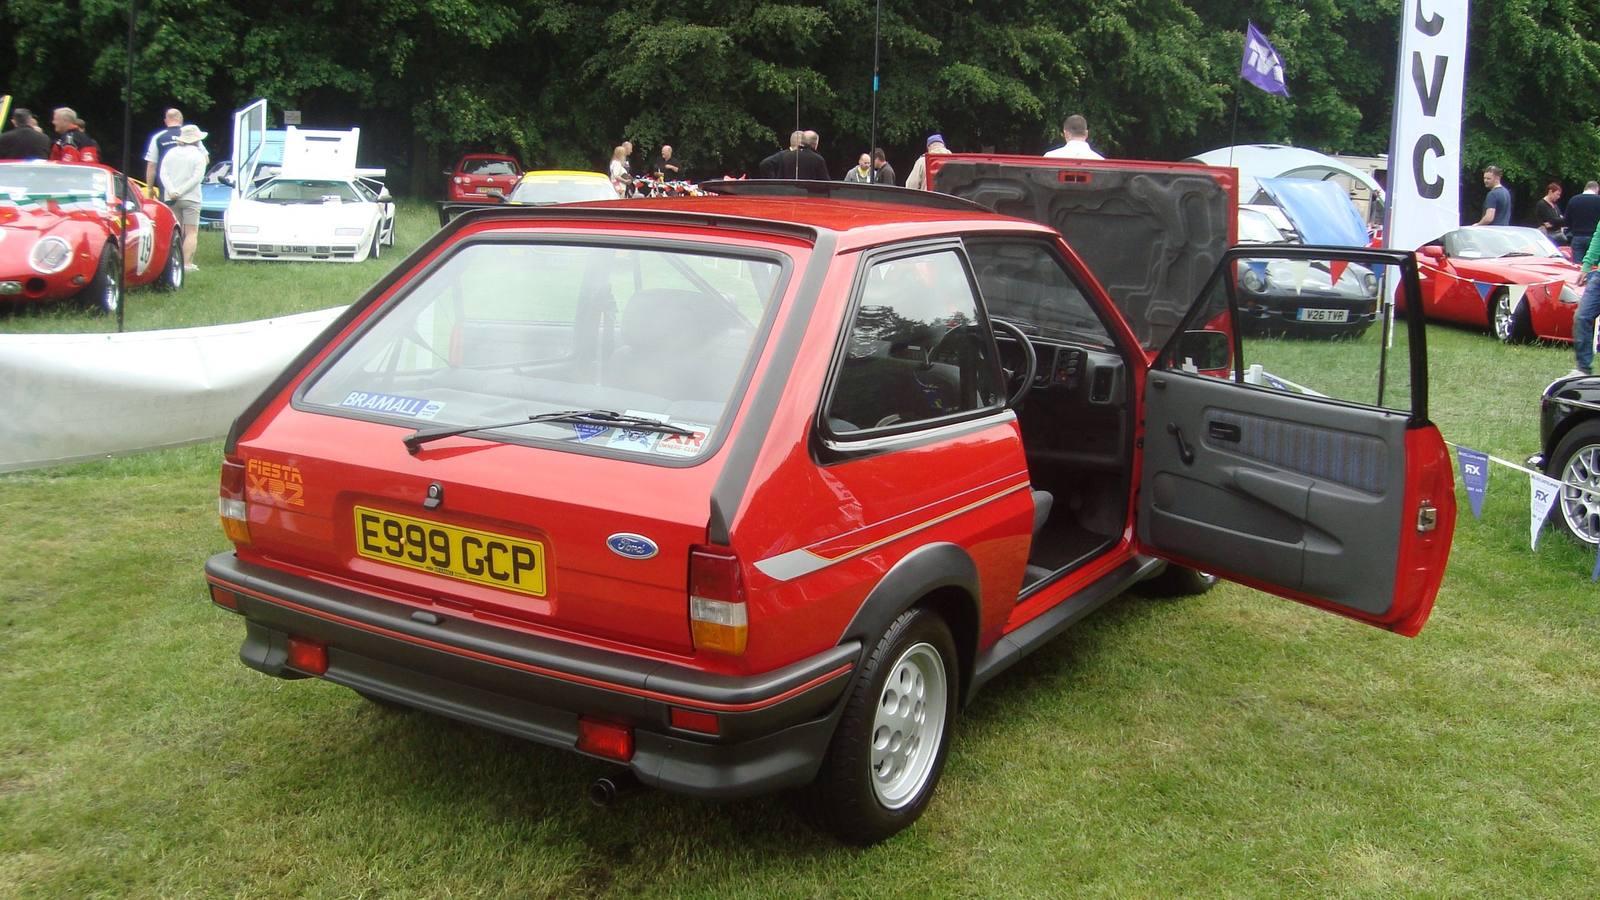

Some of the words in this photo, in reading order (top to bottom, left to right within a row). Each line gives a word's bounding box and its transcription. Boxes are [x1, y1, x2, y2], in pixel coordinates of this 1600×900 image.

[1327, 310, 1345, 322] TVR
[342, 391, 420, 415] BRAMALL
[248, 458, 303, 483] FIESTA
[248, 473, 305, 507] XR2
[361, 513, 451, 568] E999
[461, 535, 536, 584] GCP
[617, 537, 646, 554] Ford
